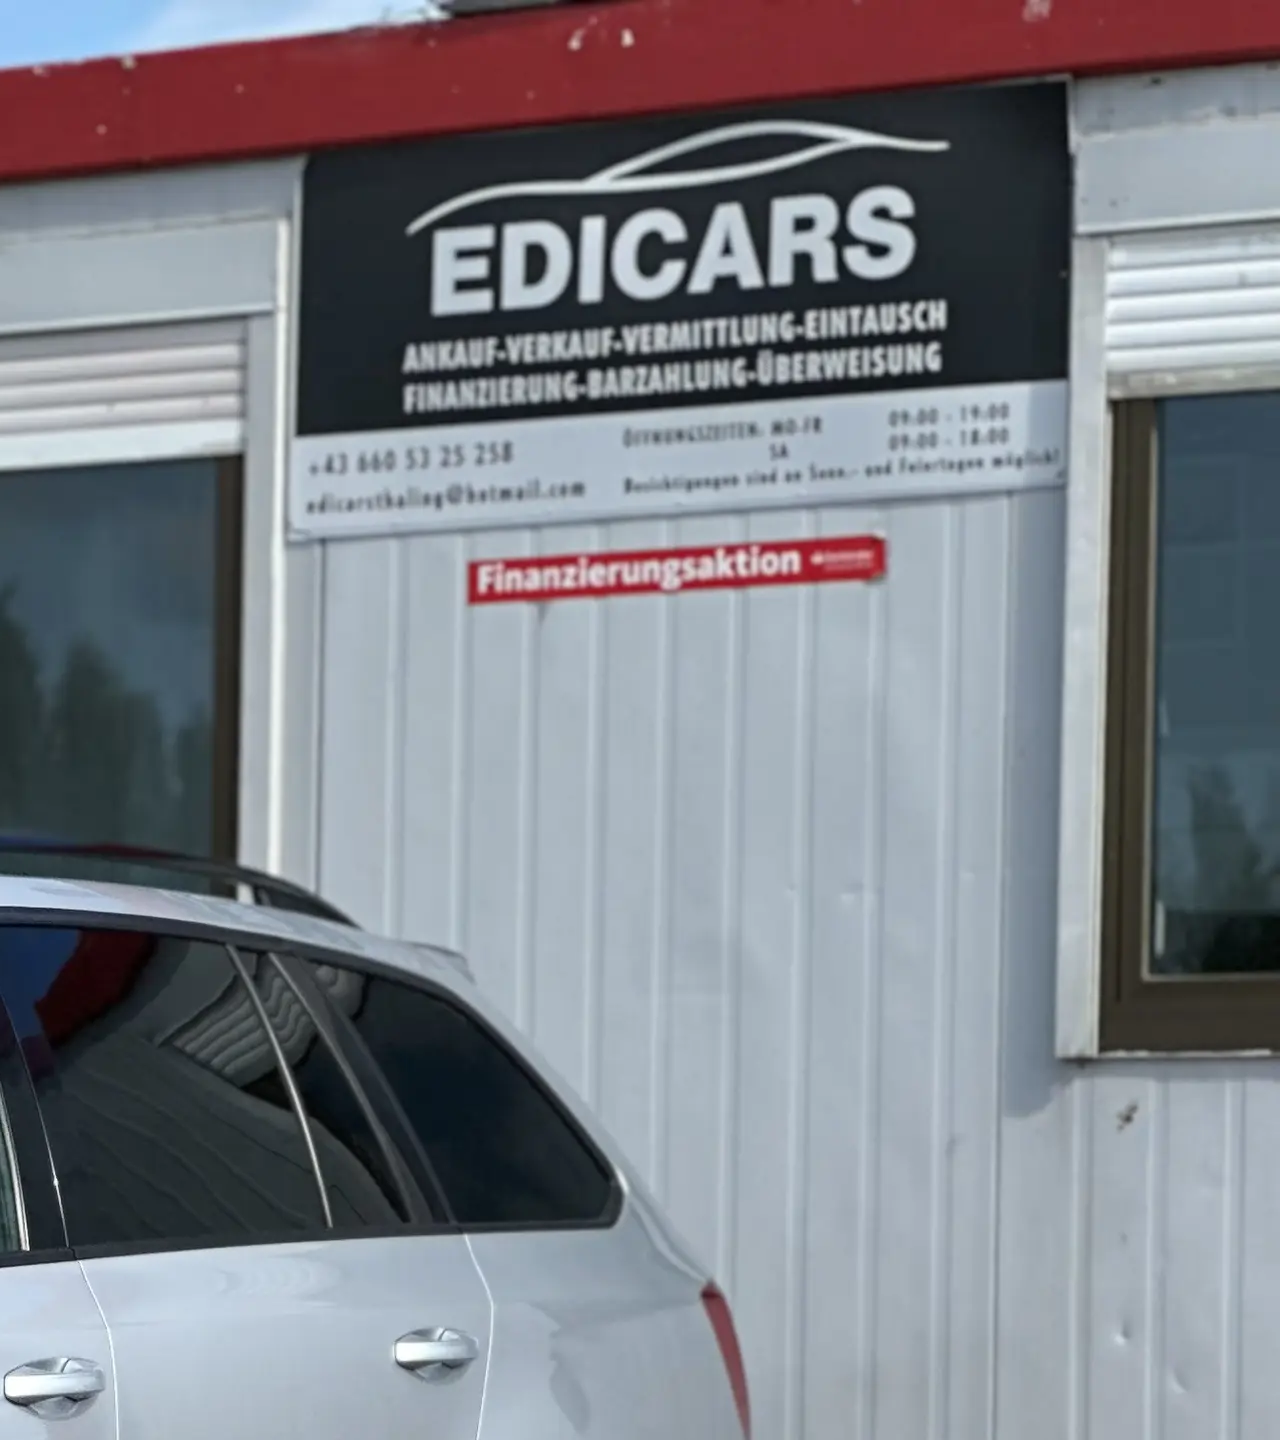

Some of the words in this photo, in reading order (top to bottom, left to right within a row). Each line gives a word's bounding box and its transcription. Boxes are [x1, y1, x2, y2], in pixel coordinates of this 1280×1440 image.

[431, 185, 916, 316] EDICARS
[309, 450, 348, 475] +43
[357, 448, 397, 474] 660
[405, 446, 430, 471] 53
[439, 444, 465, 469] 25
[474, 440, 514, 467] 258
[477, 545, 800, 594] Finanzierungsaktion
